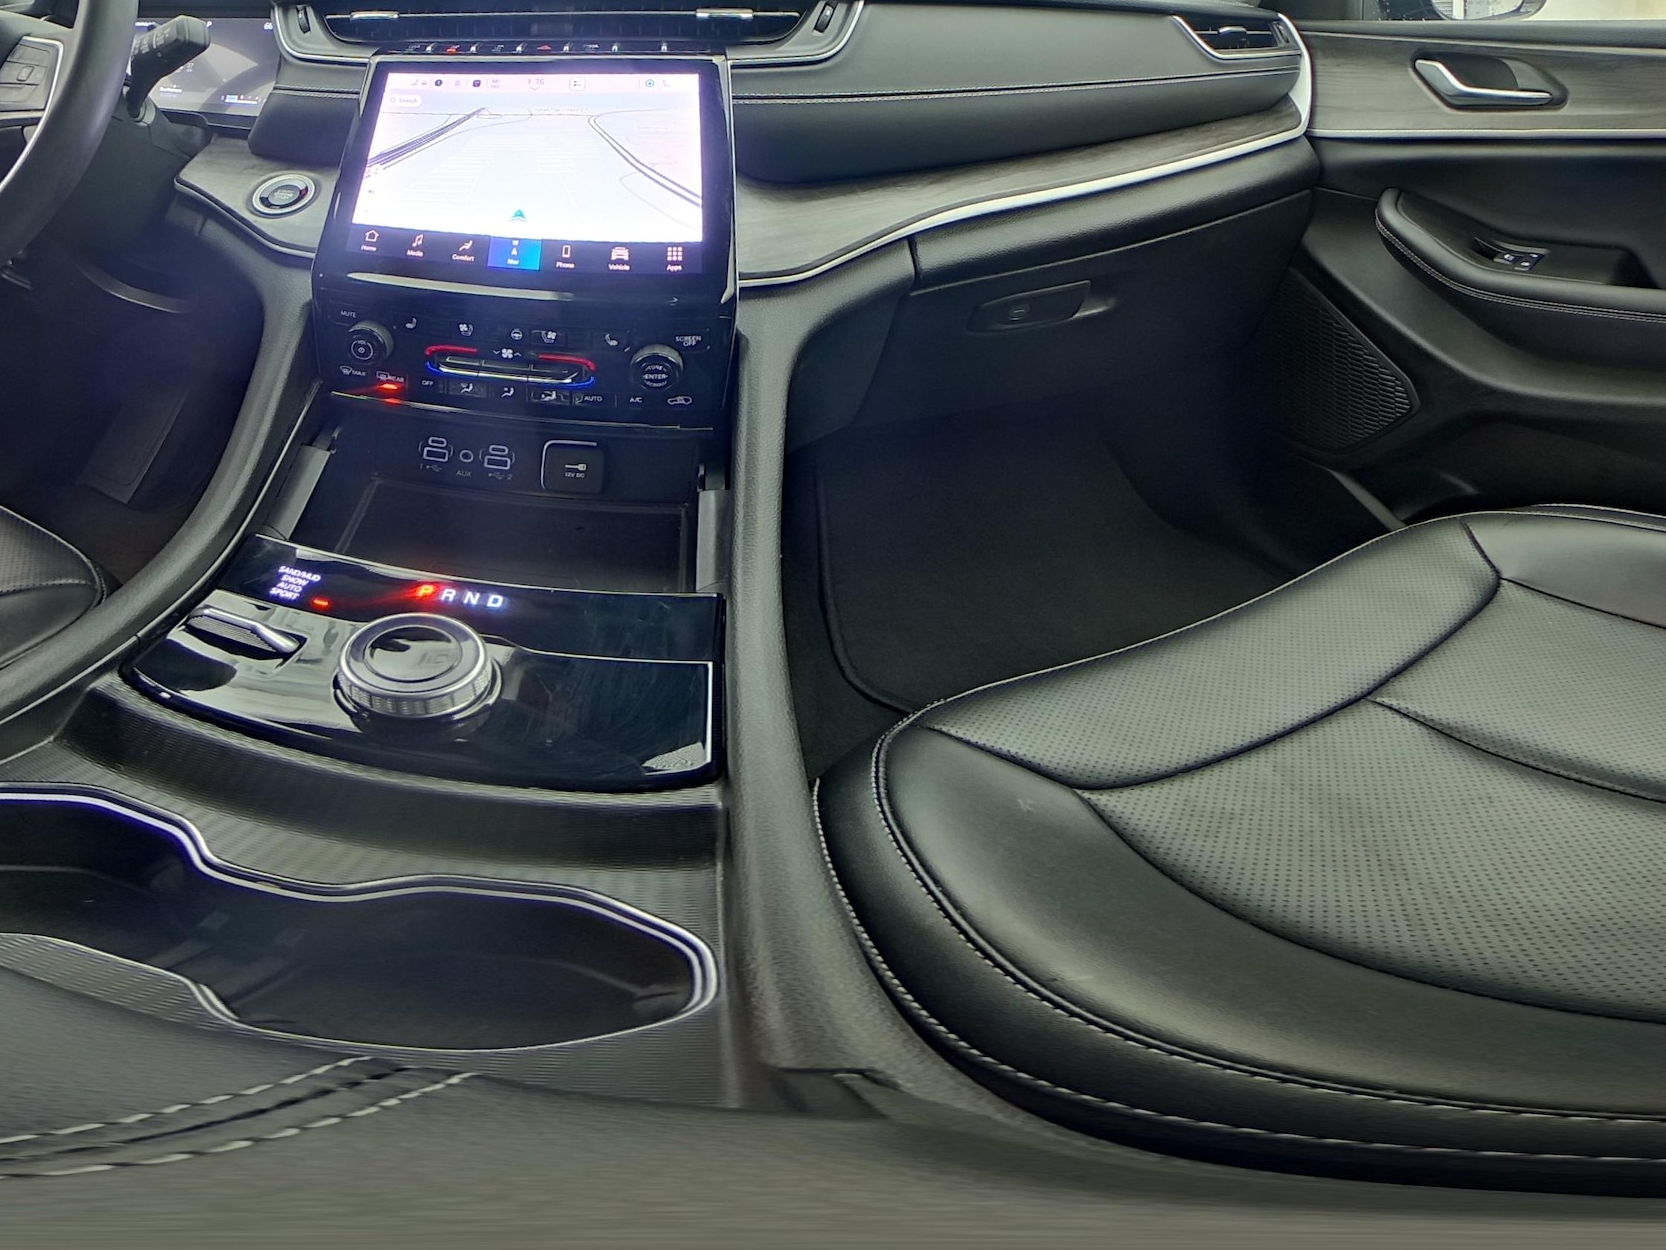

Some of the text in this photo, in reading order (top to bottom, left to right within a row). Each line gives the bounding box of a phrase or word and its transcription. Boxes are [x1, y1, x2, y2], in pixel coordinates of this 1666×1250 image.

[361, 244, 377, 252] Home
[406, 249, 424, 257] Media
[452, 253, 475, 262] Comfort
[556, 261, 575, 269] Phone
[608, 263, 630, 271] Vehicle
[666, 264, 682, 272] Apps
[340, 310, 357, 318] MUTE
[456, 469, 472, 478] AUX
[278, 565, 321, 582] SAND/MUD
[281, 574, 309, 586] SNOW
[276, 581, 303, 593] AUTO
[269, 587, 300, 600] SPORT
[417, 584, 504, 608] P R N D
